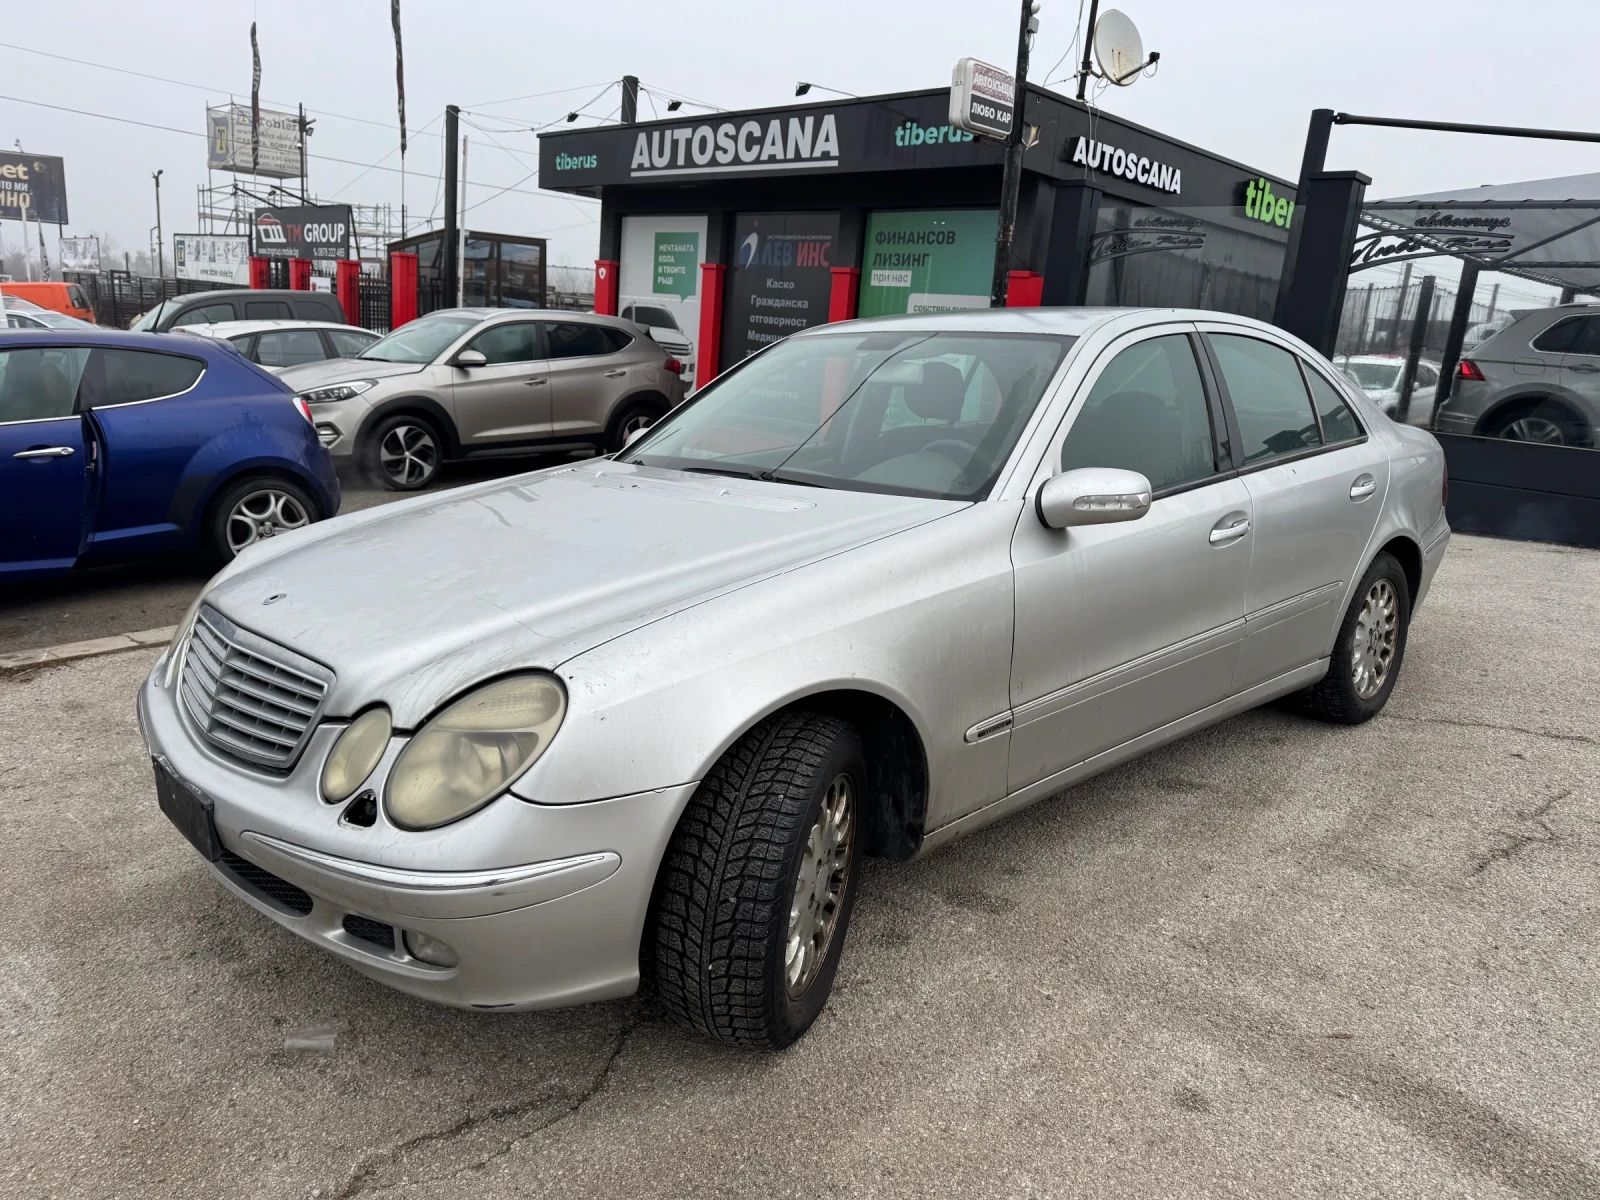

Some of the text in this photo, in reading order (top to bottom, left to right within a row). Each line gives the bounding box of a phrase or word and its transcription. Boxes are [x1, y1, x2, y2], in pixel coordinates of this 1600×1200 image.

[971, 102, 1011, 124] ЛЮБО КАР
[556, 114, 974, 170] tiberus AUTOSCANA tiberus
[1072, 136, 1181, 194] AUTOSCANA
[285, 223, 345, 243] TM GROUP
[875, 230, 956, 245] ФИНАНСОВ
[658, 244, 694, 252] МЕЧТАНАТА
[762, 241, 831, 267] ЛЕВ ИНС
[658, 255, 675, 263] КОЛА
[873, 253, 930, 267] ЛИЗИНГ
[658, 266, 686, 274] В ТВОИТЕ
[657, 276, 674, 285] РЪЦЕ
[766, 278, 795, 289] Каско
[873, 273, 909, 283] при нас
[751, 295, 809, 309] Гражданска
[749, 315, 807, 327] отговорност
